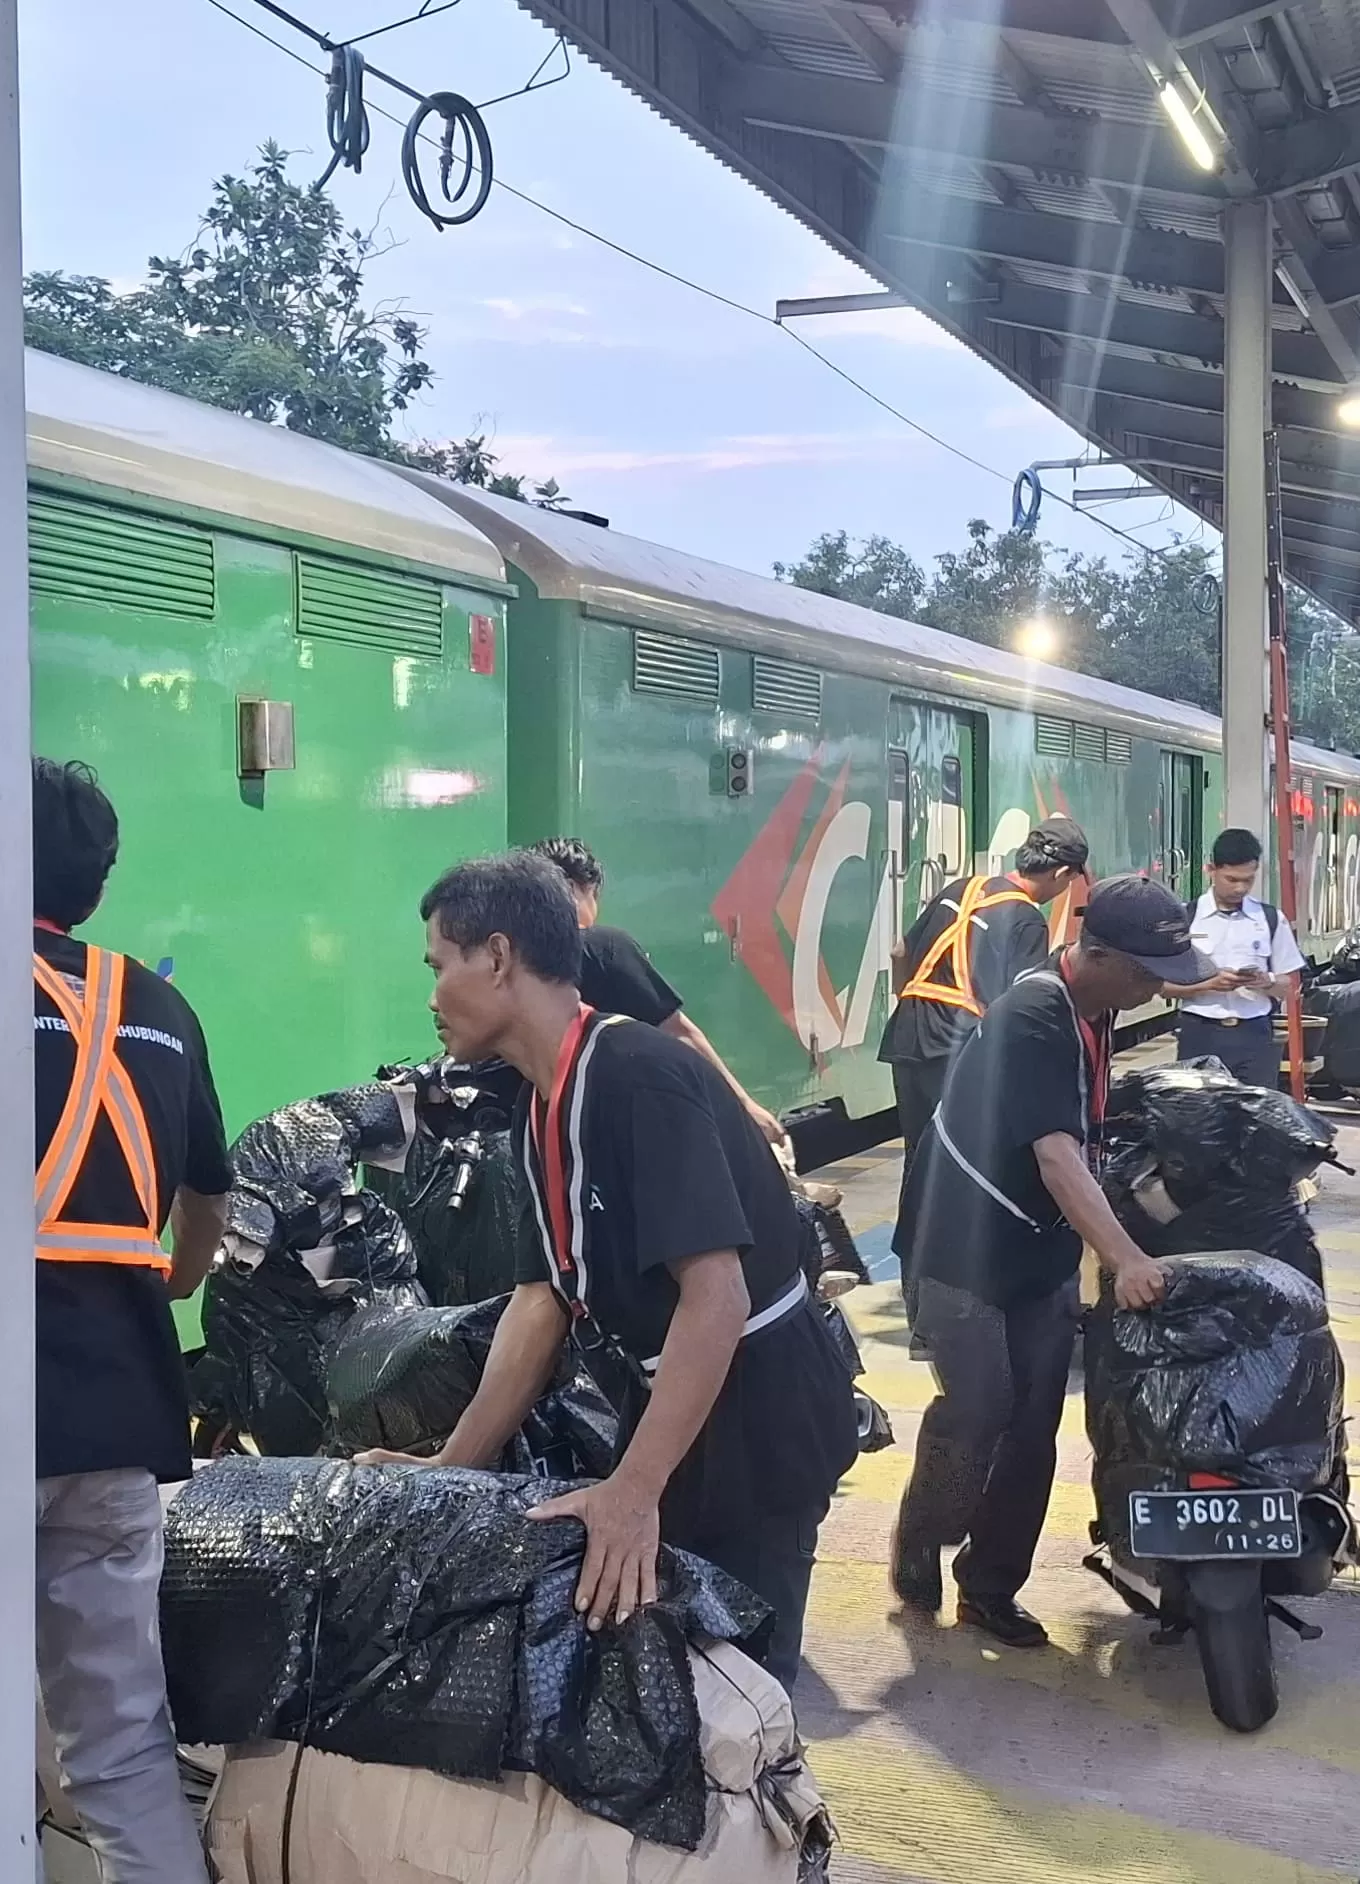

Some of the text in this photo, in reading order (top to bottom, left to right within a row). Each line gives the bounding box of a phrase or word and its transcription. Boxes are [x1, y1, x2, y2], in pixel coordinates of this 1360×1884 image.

[1134, 1495, 1293, 1525] E 3602 DL
